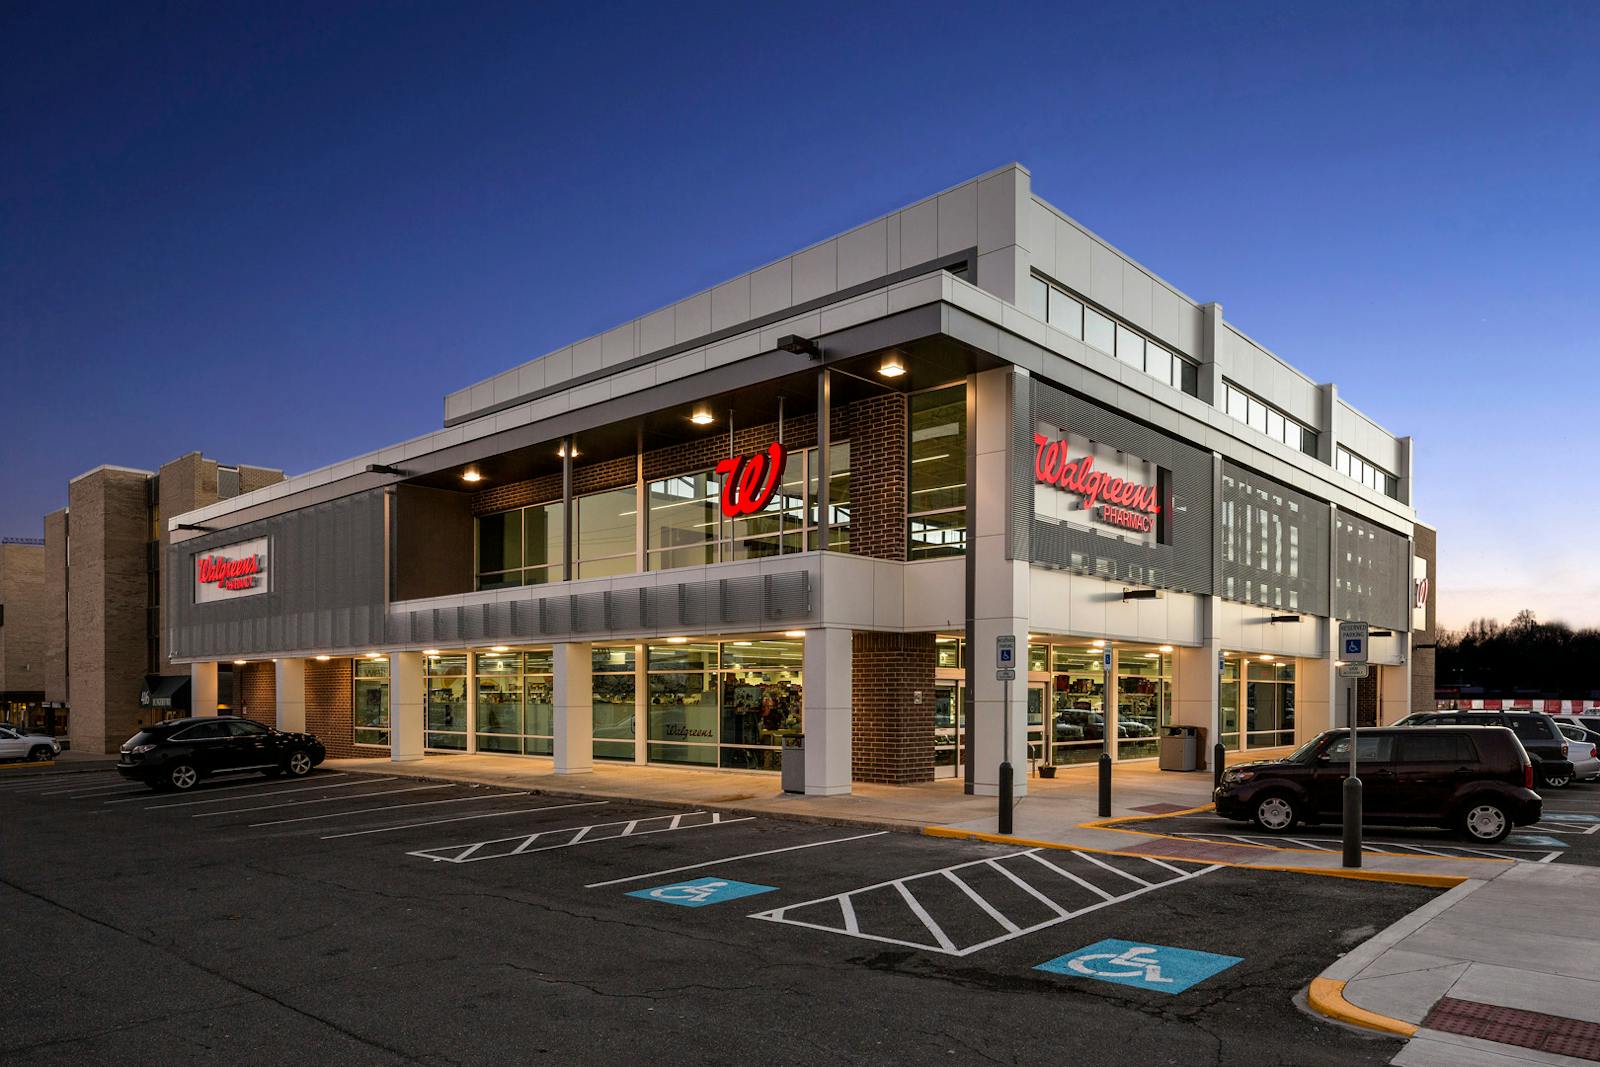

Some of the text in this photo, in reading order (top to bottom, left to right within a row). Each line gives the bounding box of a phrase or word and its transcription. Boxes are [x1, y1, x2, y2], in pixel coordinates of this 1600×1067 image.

[715, 441, 787, 518] W
[1033, 432, 1160, 510] Walgreens
[1103, 504, 1155, 532] PHARMACY
[197, 553, 259, 589] Walgreens
[666, 724, 713, 740] Walgreens
